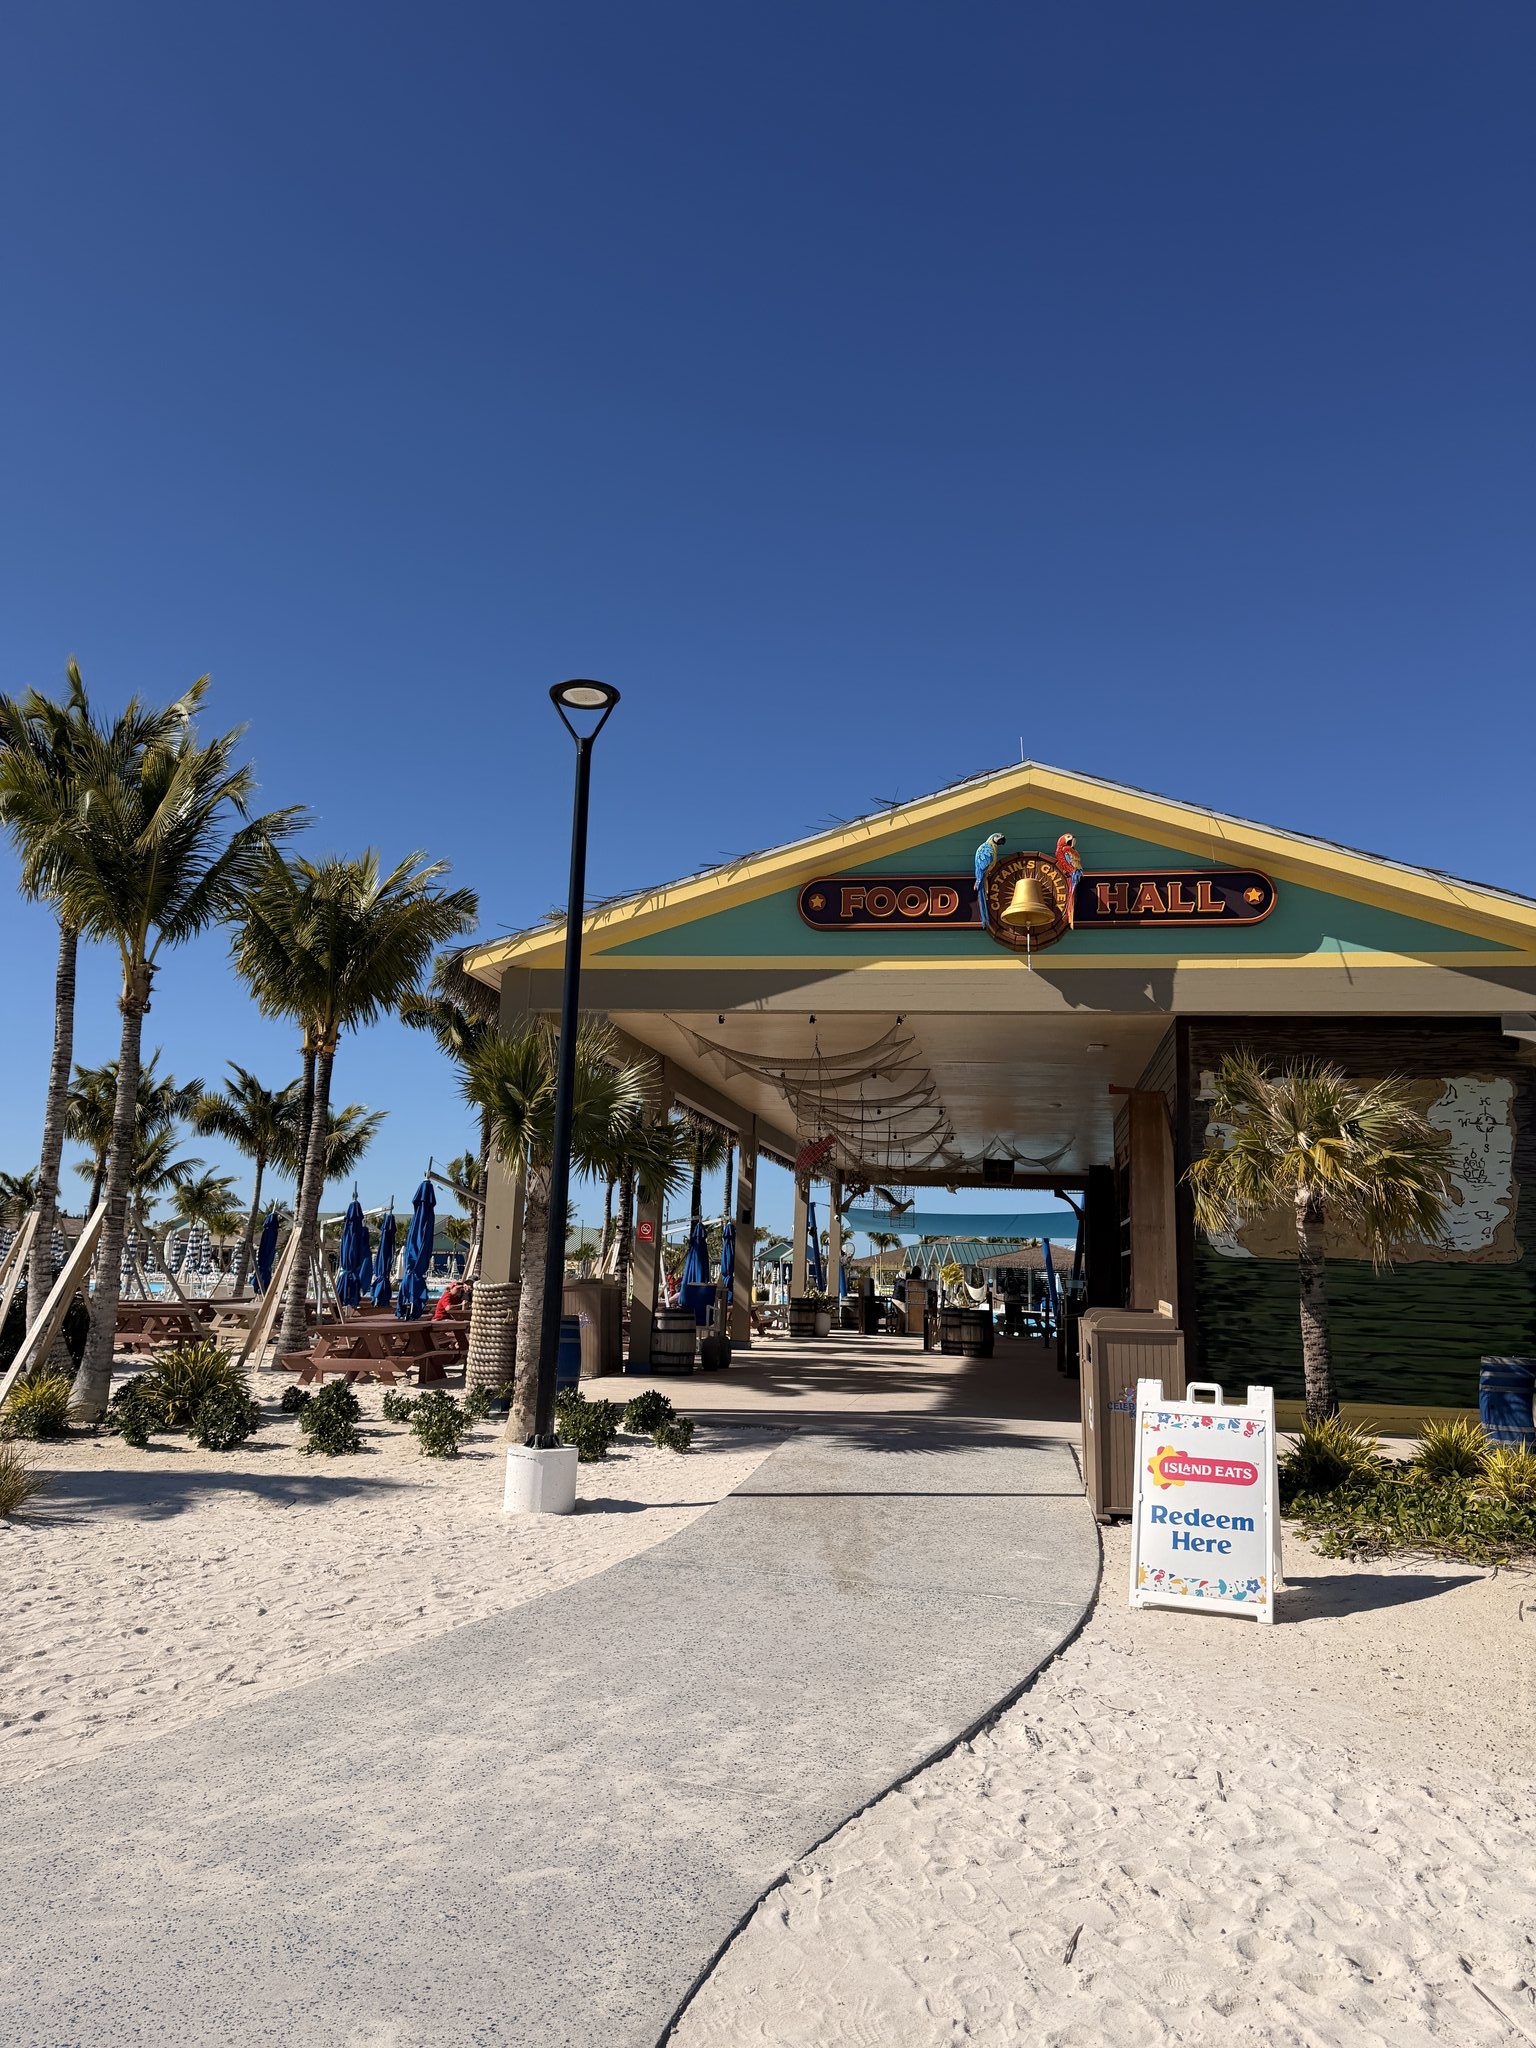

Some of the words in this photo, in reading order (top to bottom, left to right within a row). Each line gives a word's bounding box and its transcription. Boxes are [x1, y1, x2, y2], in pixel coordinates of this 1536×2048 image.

[990, 860, 1036, 911] CAPTAIN'S
[840, 886, 960, 918] FOOD
[1096, 881, 1226, 914] HALL
[1484, 1143, 1490, 1153] S
[1164, 1462, 1211, 1475] ISLAND
[1215, 1465, 1252, 1479] EATS
[1151, 1504, 1255, 1532] Redeem
[1172, 1531, 1232, 1555] Here
